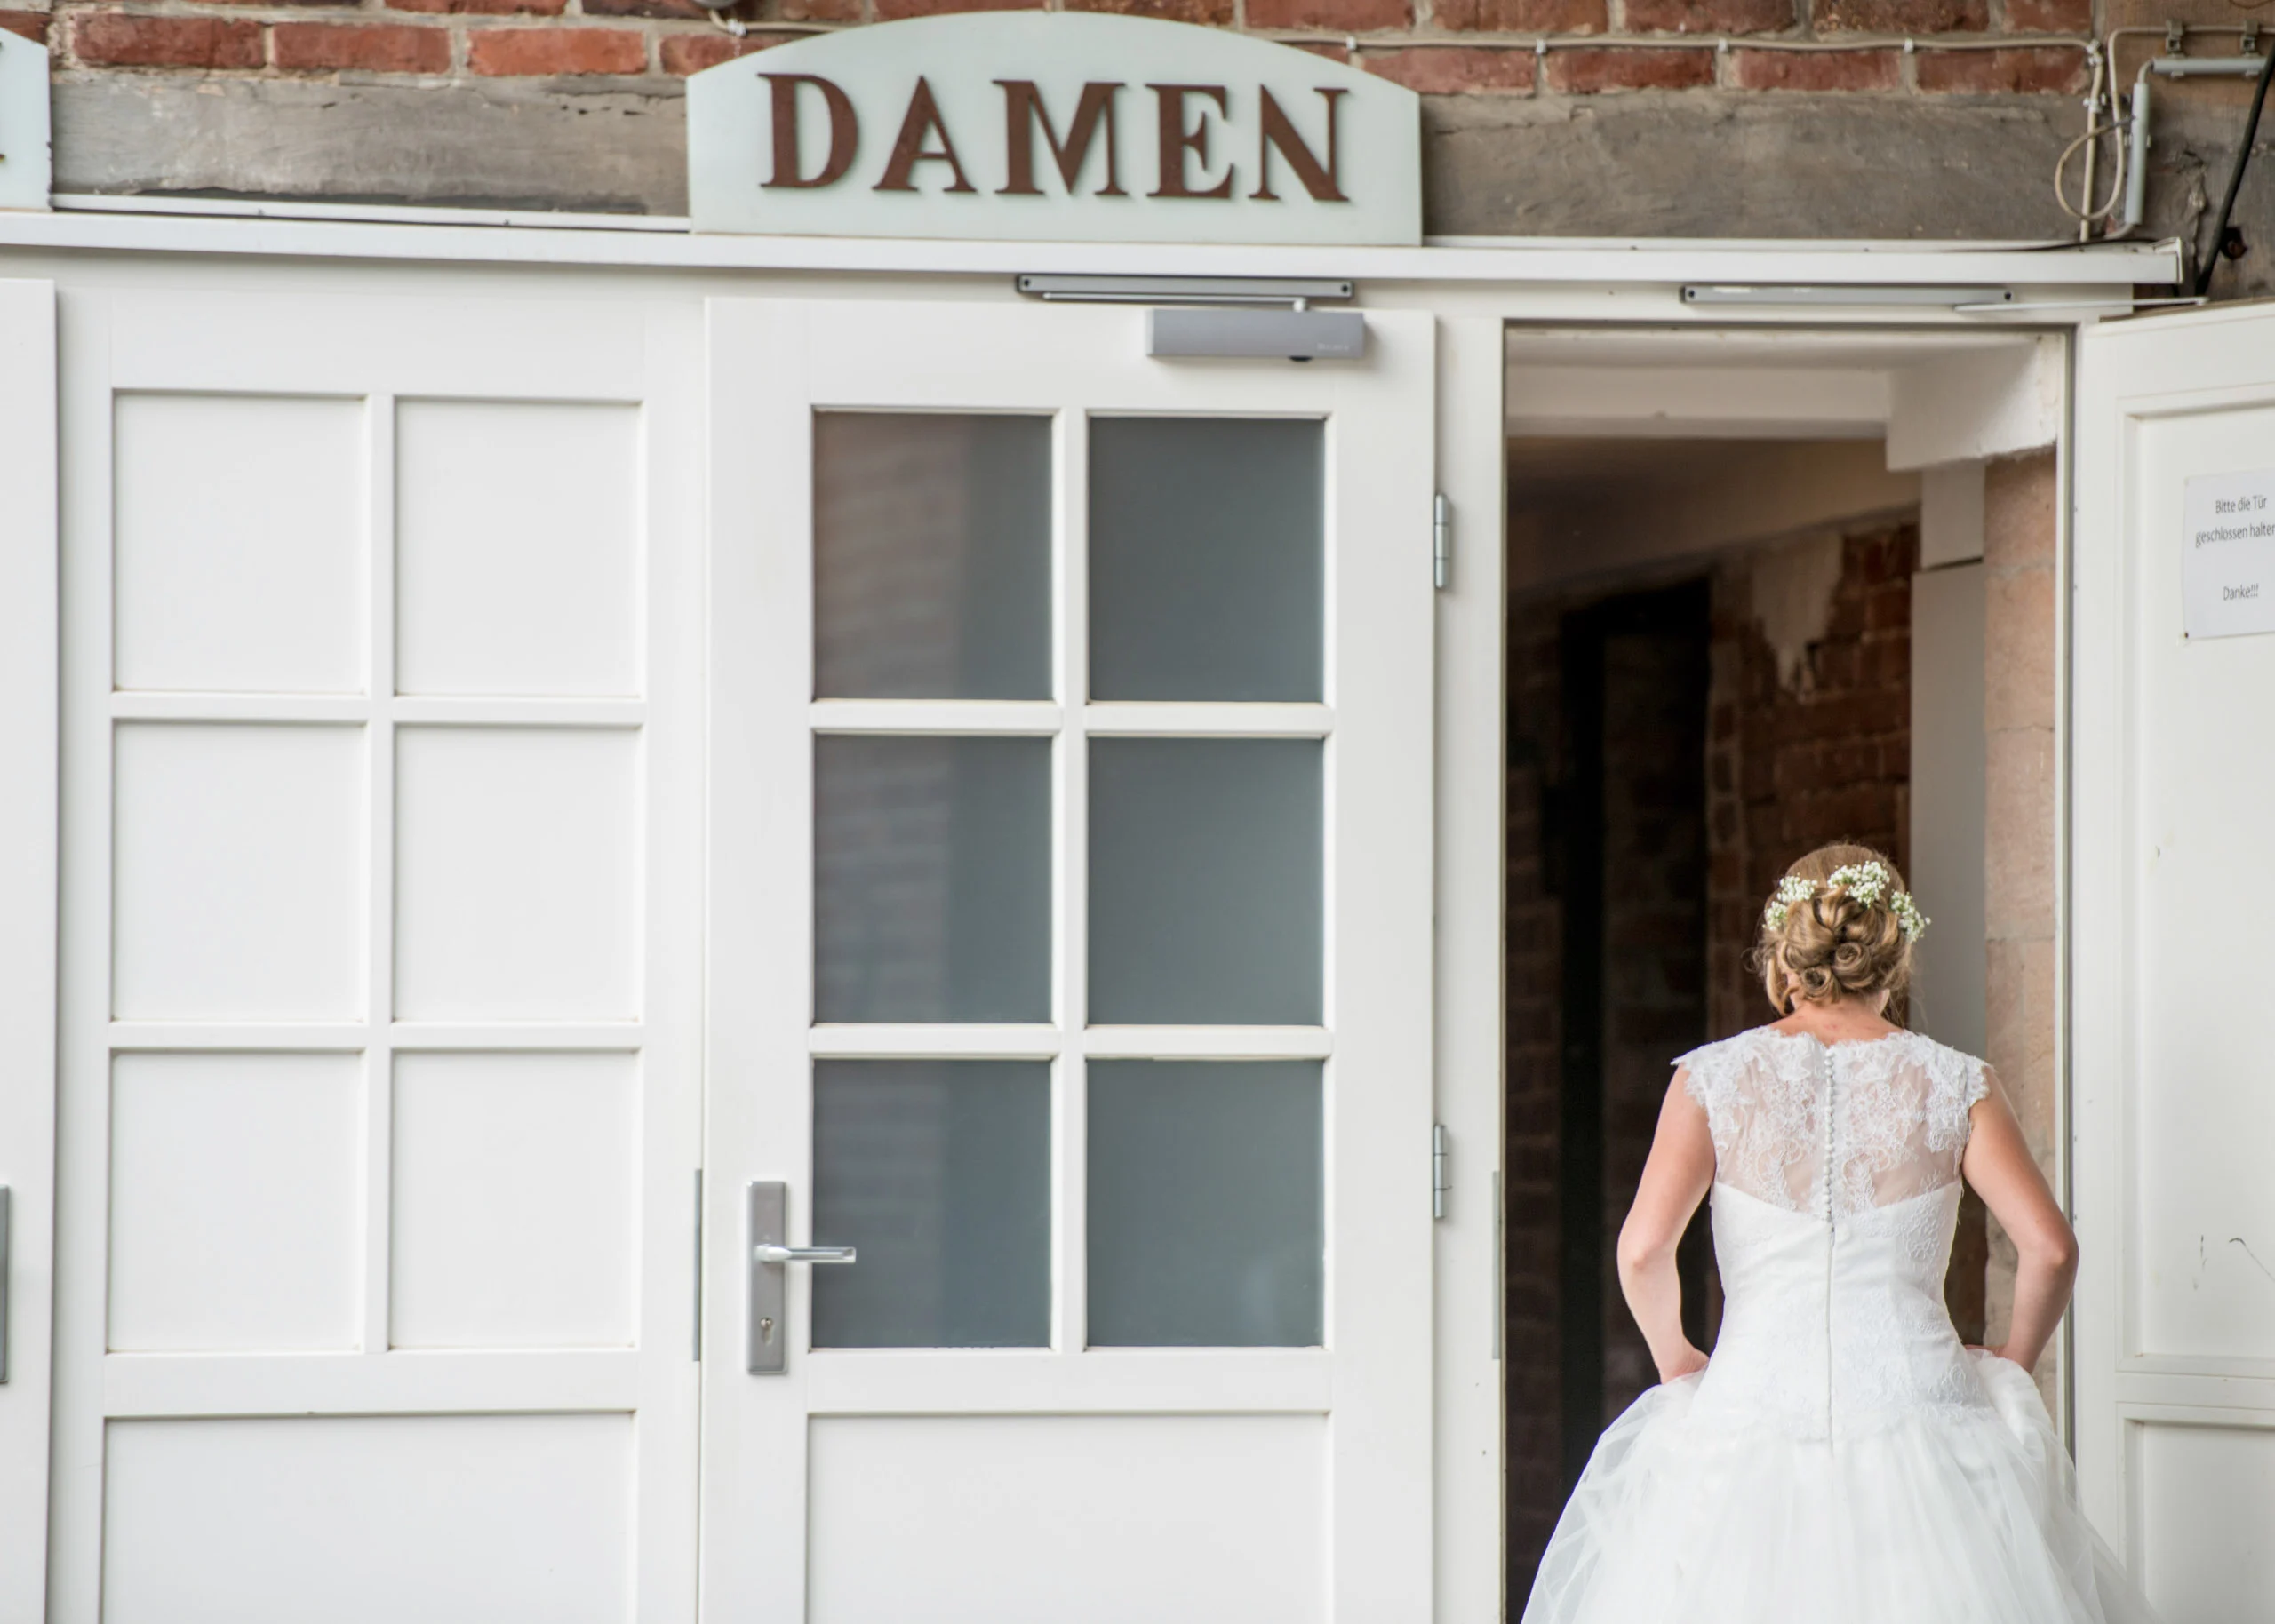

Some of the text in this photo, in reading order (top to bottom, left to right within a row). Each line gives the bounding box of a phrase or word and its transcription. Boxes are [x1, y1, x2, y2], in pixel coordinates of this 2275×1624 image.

[758, 72, 1350, 202] DAMEN
[2215, 494, 2268, 514] Bitte die Tür
[2195, 526, 2248, 548] geschlossen
[2223, 583, 2259, 601] Danke!!!
